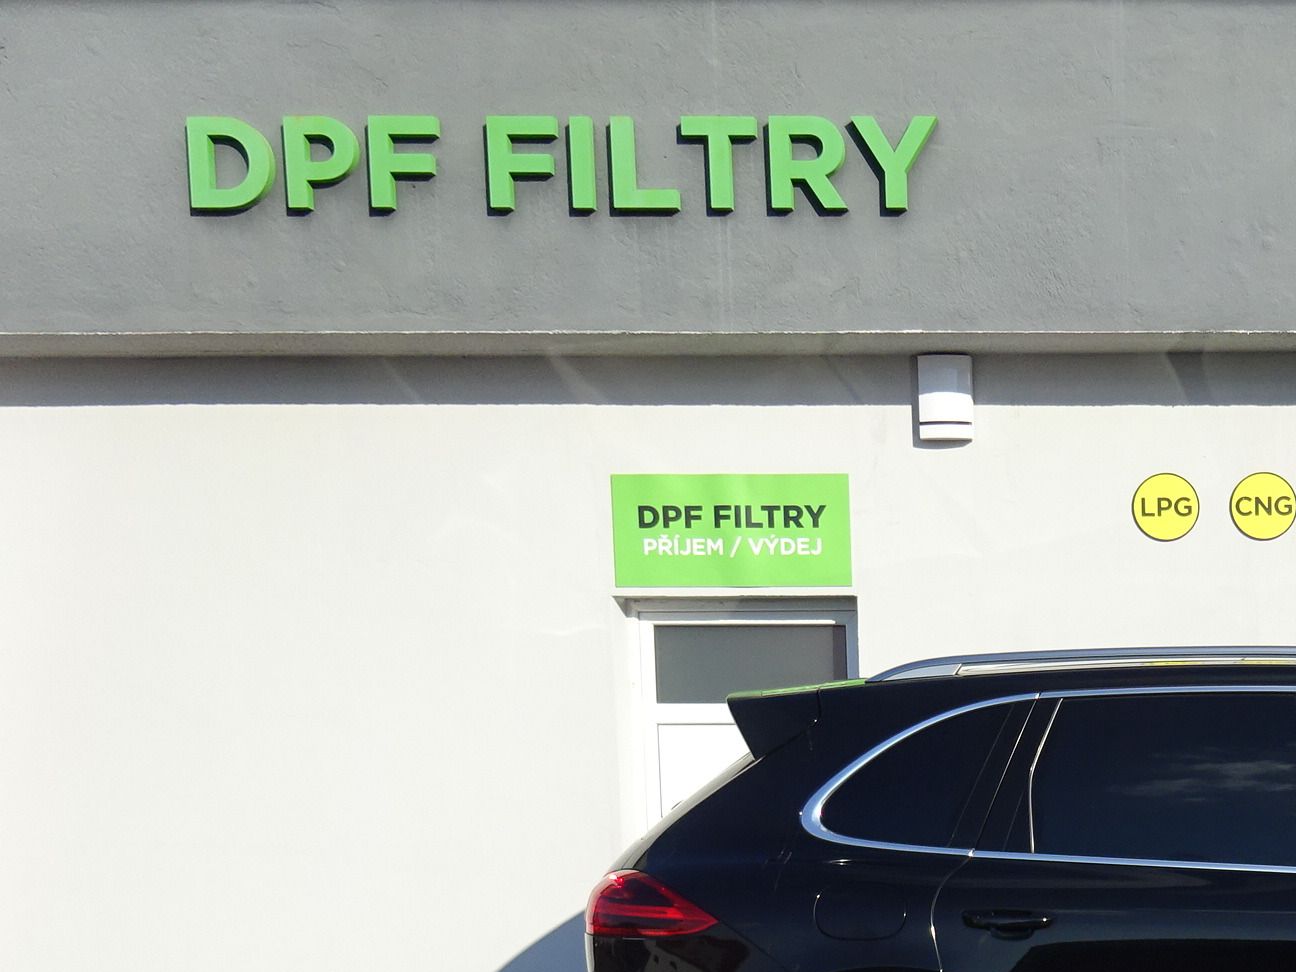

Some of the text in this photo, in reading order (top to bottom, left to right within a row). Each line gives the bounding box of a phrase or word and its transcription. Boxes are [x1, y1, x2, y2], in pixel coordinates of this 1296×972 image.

[186, 115, 938, 213] DPF FILTRY
[637, 505, 827, 529] DPF FILTRY
[1141, 497, 1192, 517] LPG
[1235, 496, 1293, 516] CNG
[643, 534, 724, 556] PŘÍJEM
[748, 534, 823, 556] VÝDEJ
